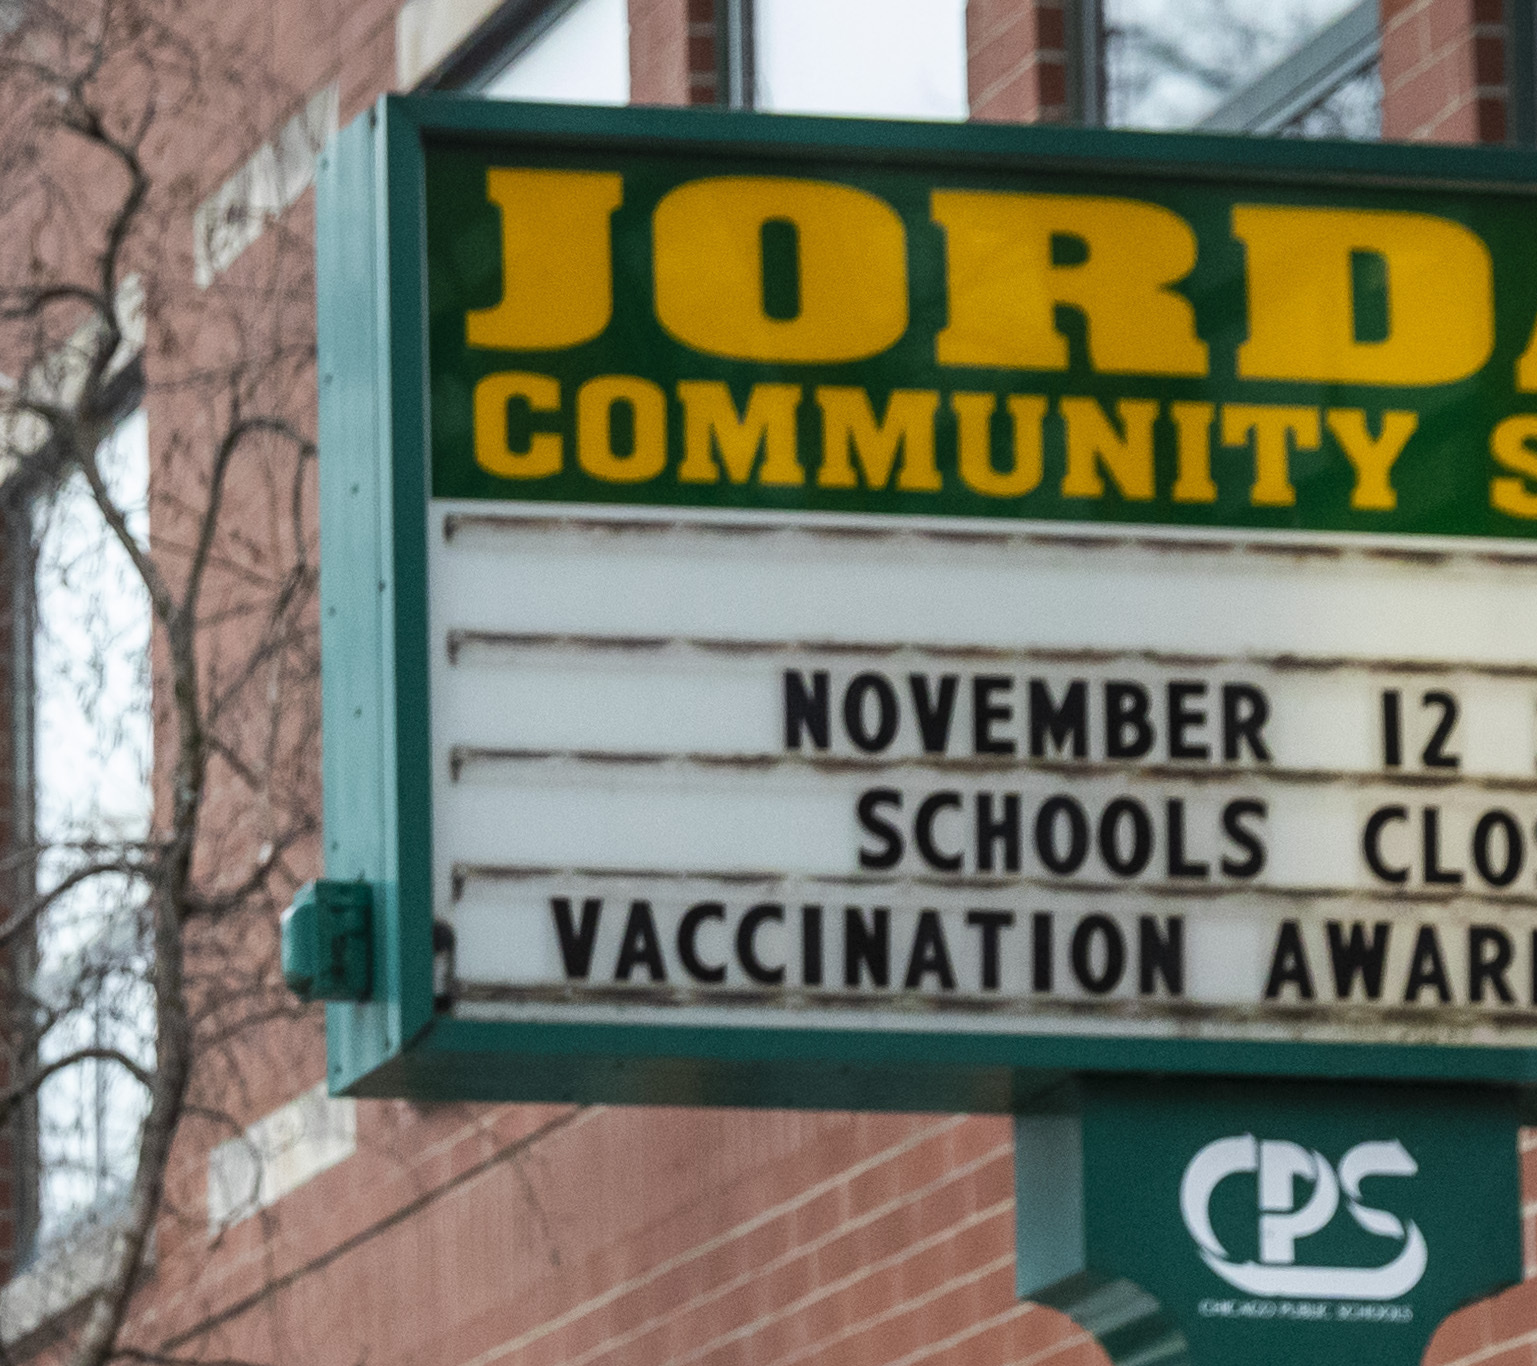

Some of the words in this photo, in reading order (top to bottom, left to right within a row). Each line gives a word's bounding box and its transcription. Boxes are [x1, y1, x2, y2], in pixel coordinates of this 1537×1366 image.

[472, 370, 1419, 512] COMMUNITY
[783, 668, 1273, 765] NOVEMBER
[1379, 687, 1463, 771] 12
[855, 786, 1270, 881] SCHOOLS
[549, 896, 1188, 1000] VACCINATION
[1180, 1132, 1428, 1301] CPS
